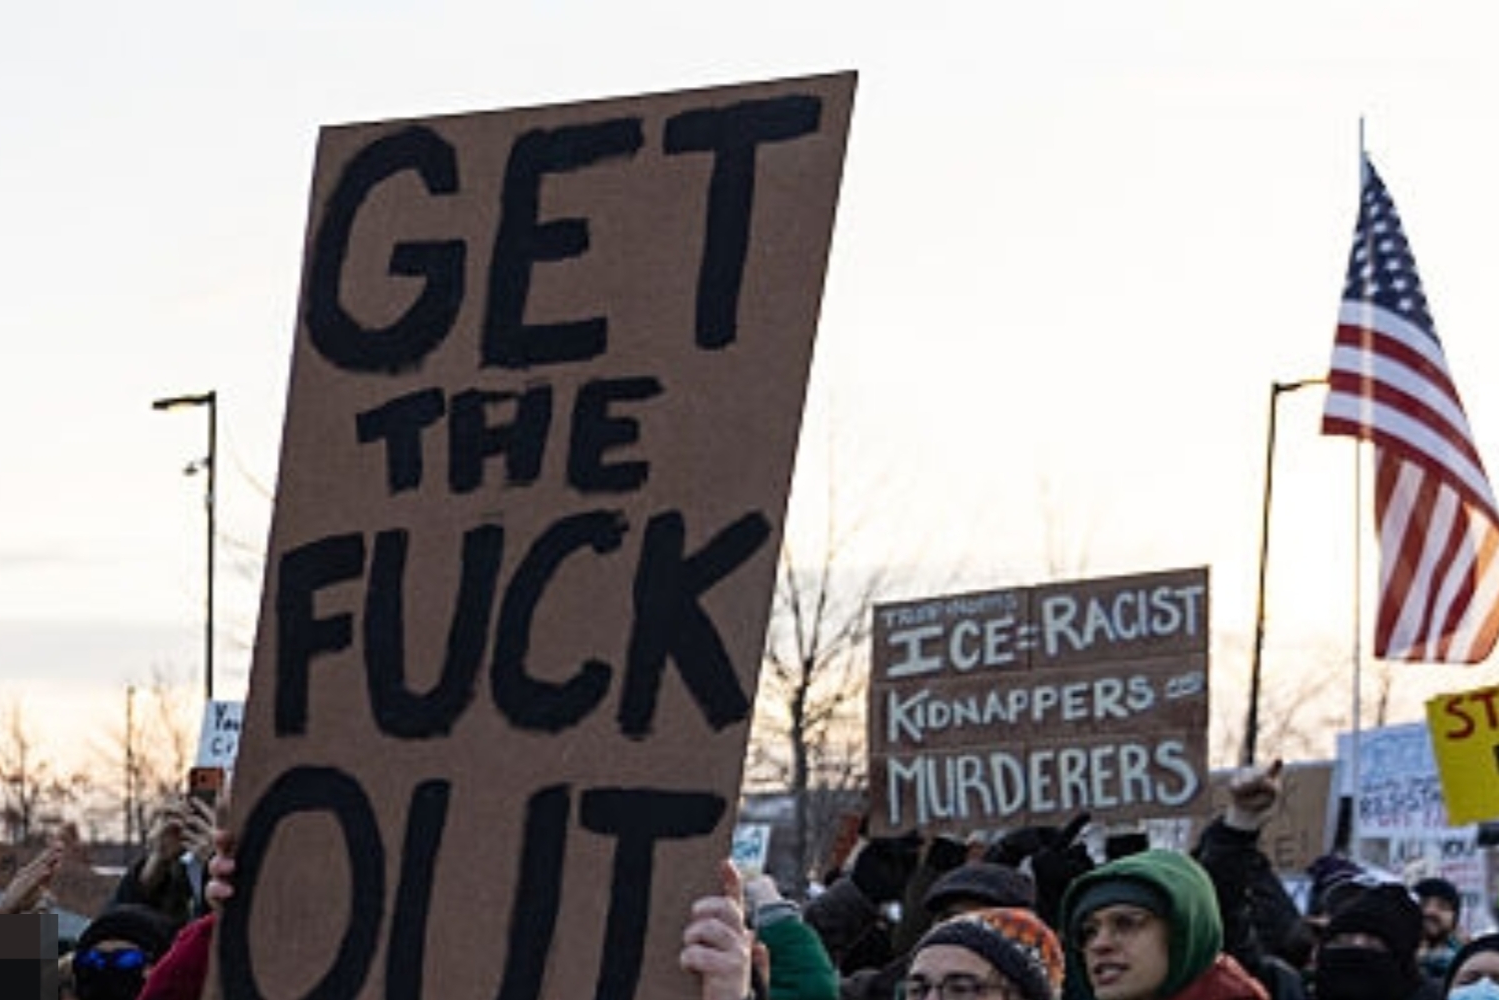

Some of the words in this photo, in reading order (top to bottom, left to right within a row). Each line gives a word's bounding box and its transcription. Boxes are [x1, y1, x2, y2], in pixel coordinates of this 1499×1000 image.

[304, 95, 822, 376] GET
[356, 376, 664, 495] THE
[274, 509, 772, 741] FUCK
[887, 741, 1199, 825] MURDERERS
